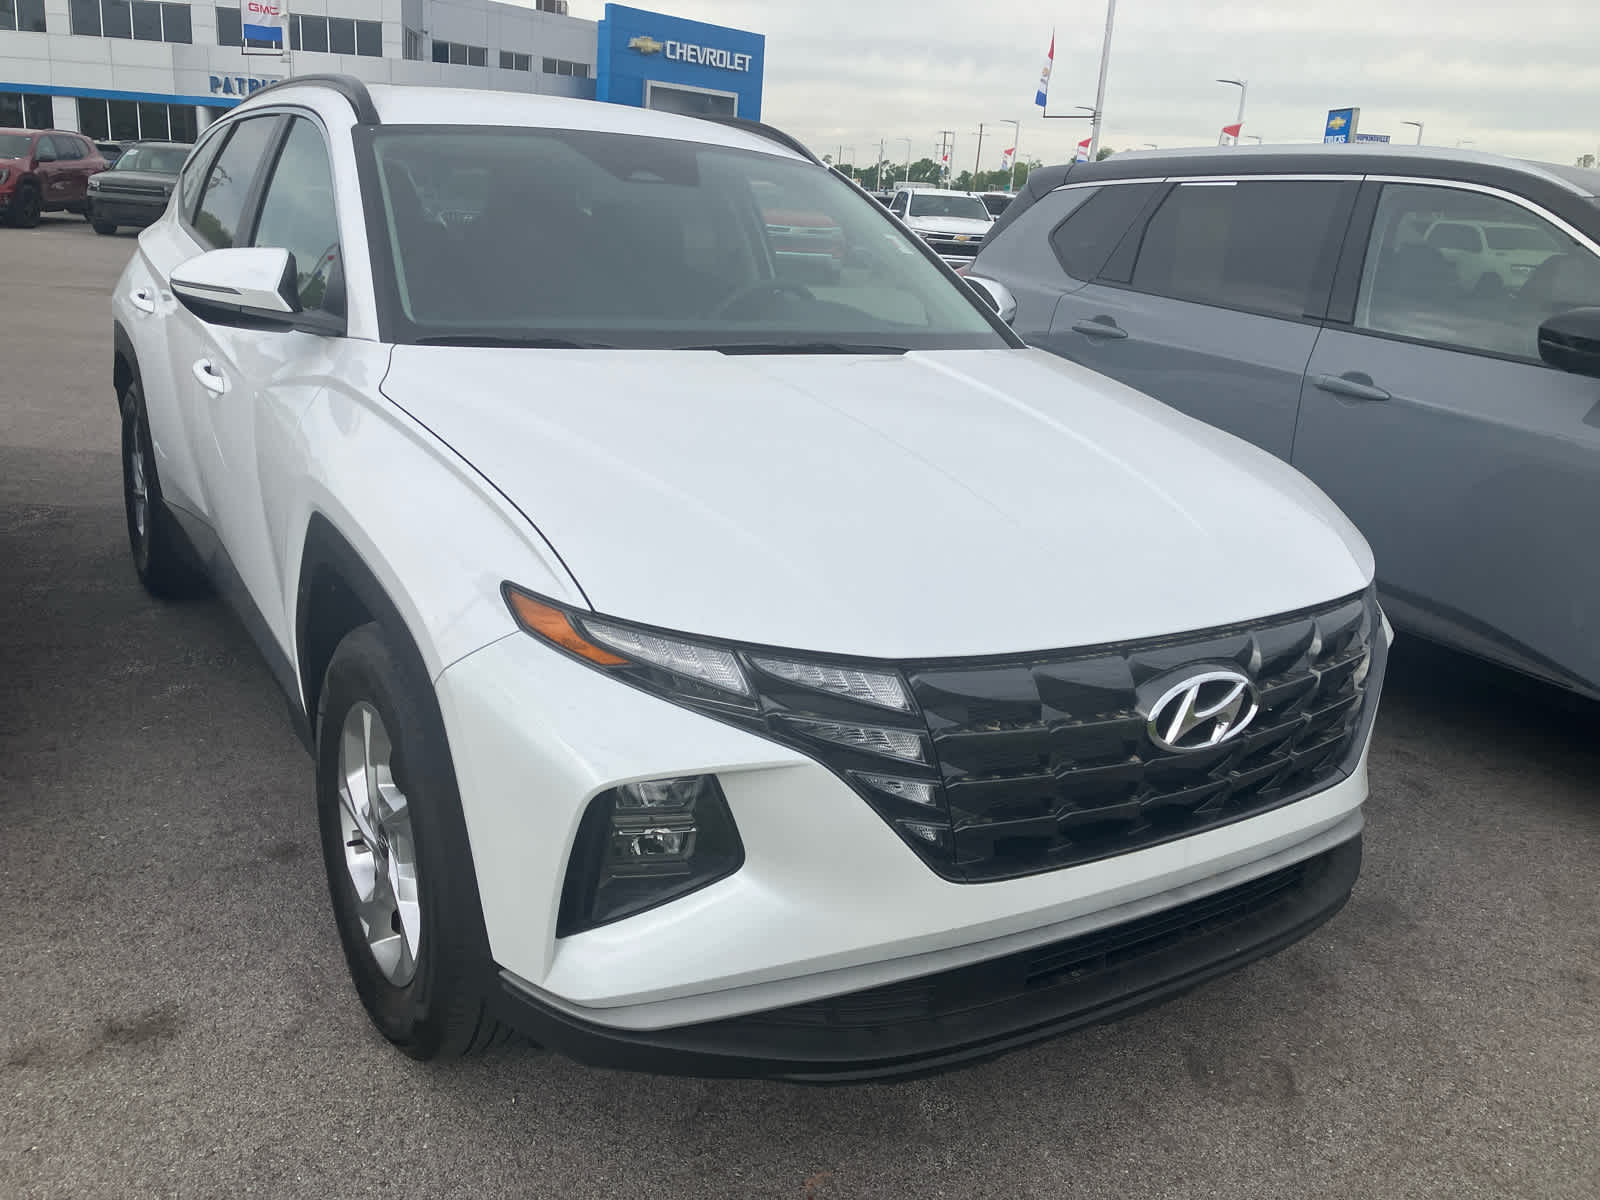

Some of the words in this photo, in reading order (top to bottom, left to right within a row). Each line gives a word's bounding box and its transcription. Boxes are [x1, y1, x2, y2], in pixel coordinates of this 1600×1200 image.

[248, 2, 280, 15] GMC
[666, 40, 752, 72] CHEVROLET
[209, 76, 279, 95] PATRI
